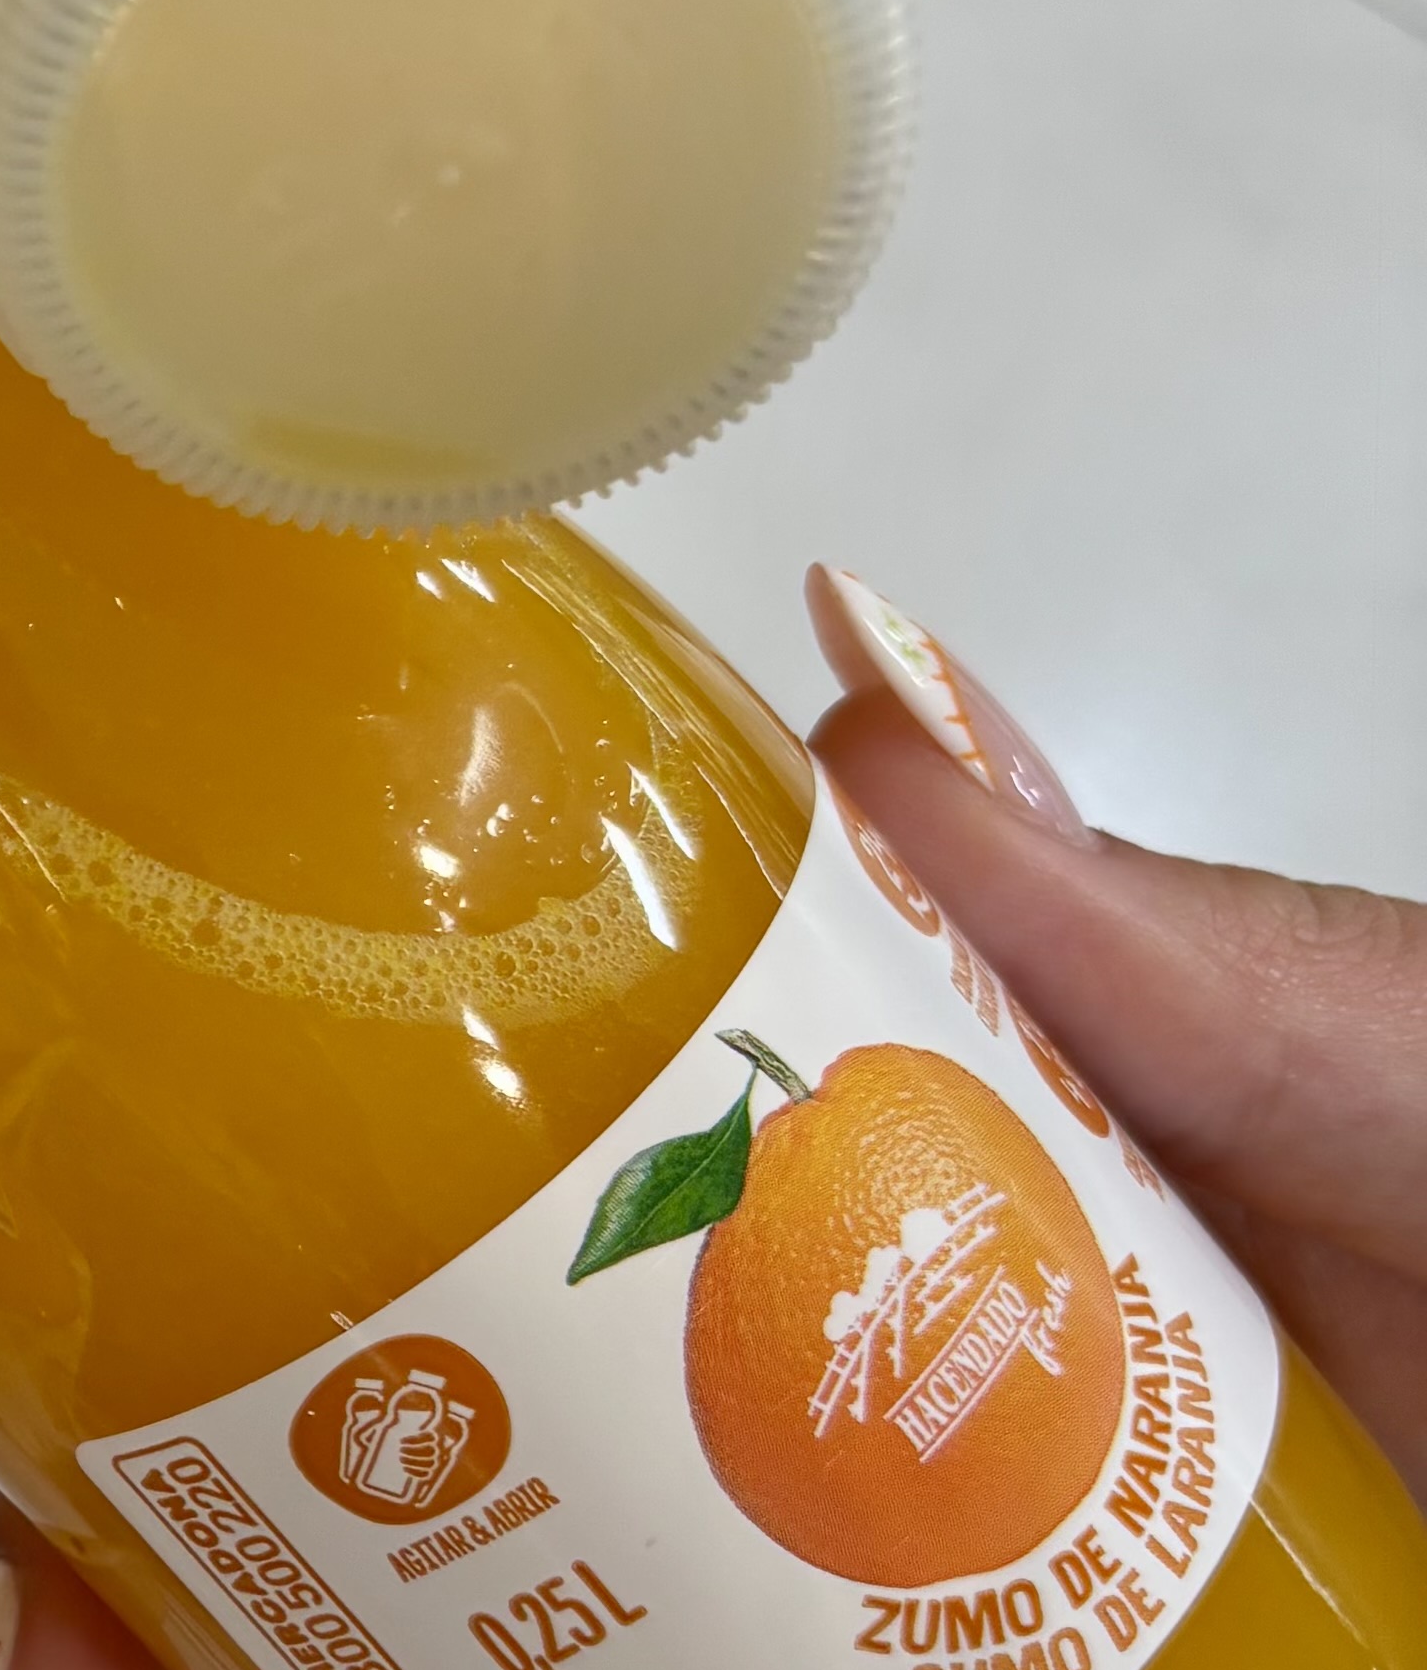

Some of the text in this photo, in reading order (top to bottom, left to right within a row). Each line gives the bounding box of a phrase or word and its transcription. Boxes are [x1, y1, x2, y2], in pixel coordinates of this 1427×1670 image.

[895, 1279, 1030, 1452] HACENDADO
[1018, 1257, 1074, 1378] fresh
[165, 1455, 261, 1534] 220
[853, 1577, 1044, 1656] ZUMO
[1048, 1523, 1122, 1610] DE
[1104, 1251, 1175, 1540] NARANJA
[1092, 1566, 1167, 1653] DE
[1145, 1309, 1218, 1580] LARANJA
[234, 1533, 325, 1613] 500
[386, 1476, 562, 1584] AGITAR & ABRIR
